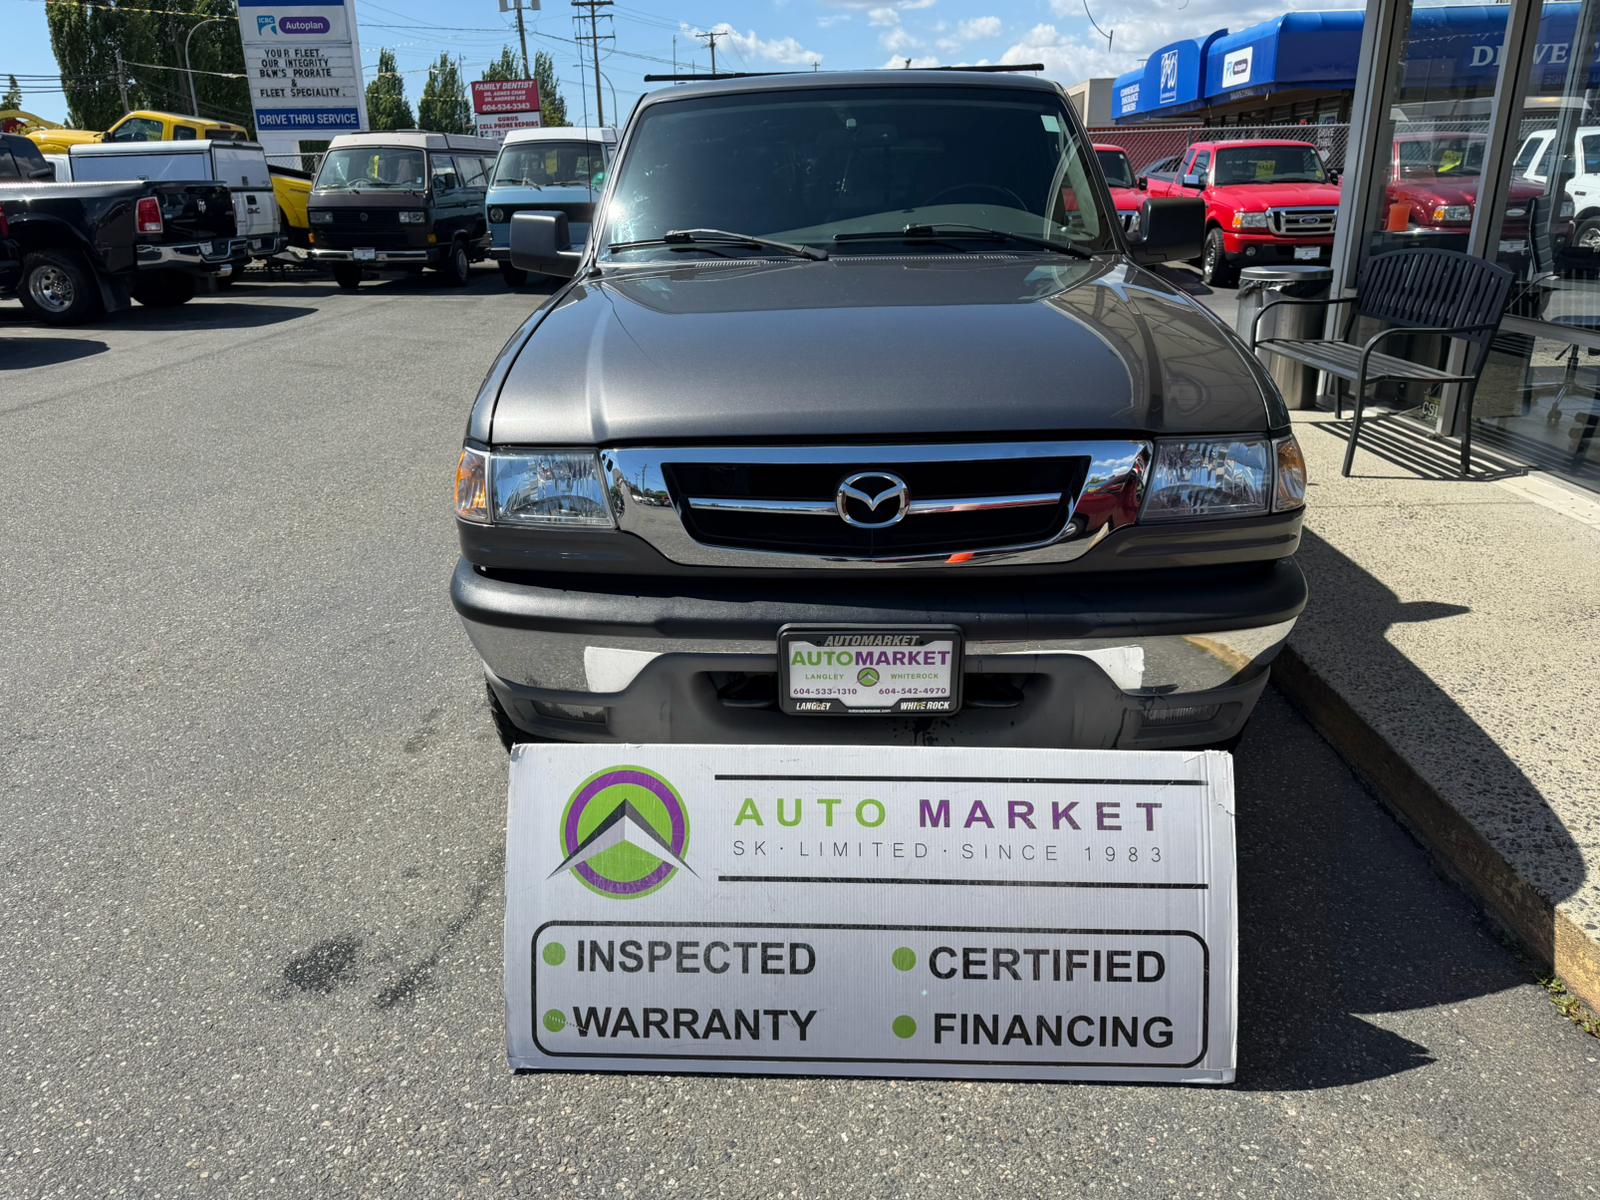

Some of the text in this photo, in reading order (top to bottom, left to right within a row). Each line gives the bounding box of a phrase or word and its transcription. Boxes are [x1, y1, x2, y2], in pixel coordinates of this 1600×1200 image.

[285, 21, 324, 31] Autoplan
[265, 49, 290, 58] YOUR
[261, 58, 329, 68] OUR INTEGRITY
[259, 68, 332, 78] B&W'S PRORATE
[291, 78, 298, 88] &
[475, 81, 534, 91] FAMILY DENTIST
[260, 88, 285, 98] FLEET
[260, 113, 357, 125] DRIVE THRU SERVICE
[514, 120, 539, 128] REPAIRS
[824, 635, 920, 647] AUTOMARKET
[791, 651, 951, 667] AUTOMARKET
[878, 687, 947, 695] 604-542-4970
[926, 701, 951, 710] ROCK
[733, 797, 1163, 832] AUTO MARKET
[800, 841, 928, 859] LIMITED
[961, 843, 1058, 861] SINCE
[1084, 846, 1162, 863] 1983
[576, 939, 817, 976] INSPECTED
[928, 946, 1166, 983] CERTIFIED
[573, 1006, 818, 1042] WARRANTY
[934, 1012, 1174, 1049] FINANCING
